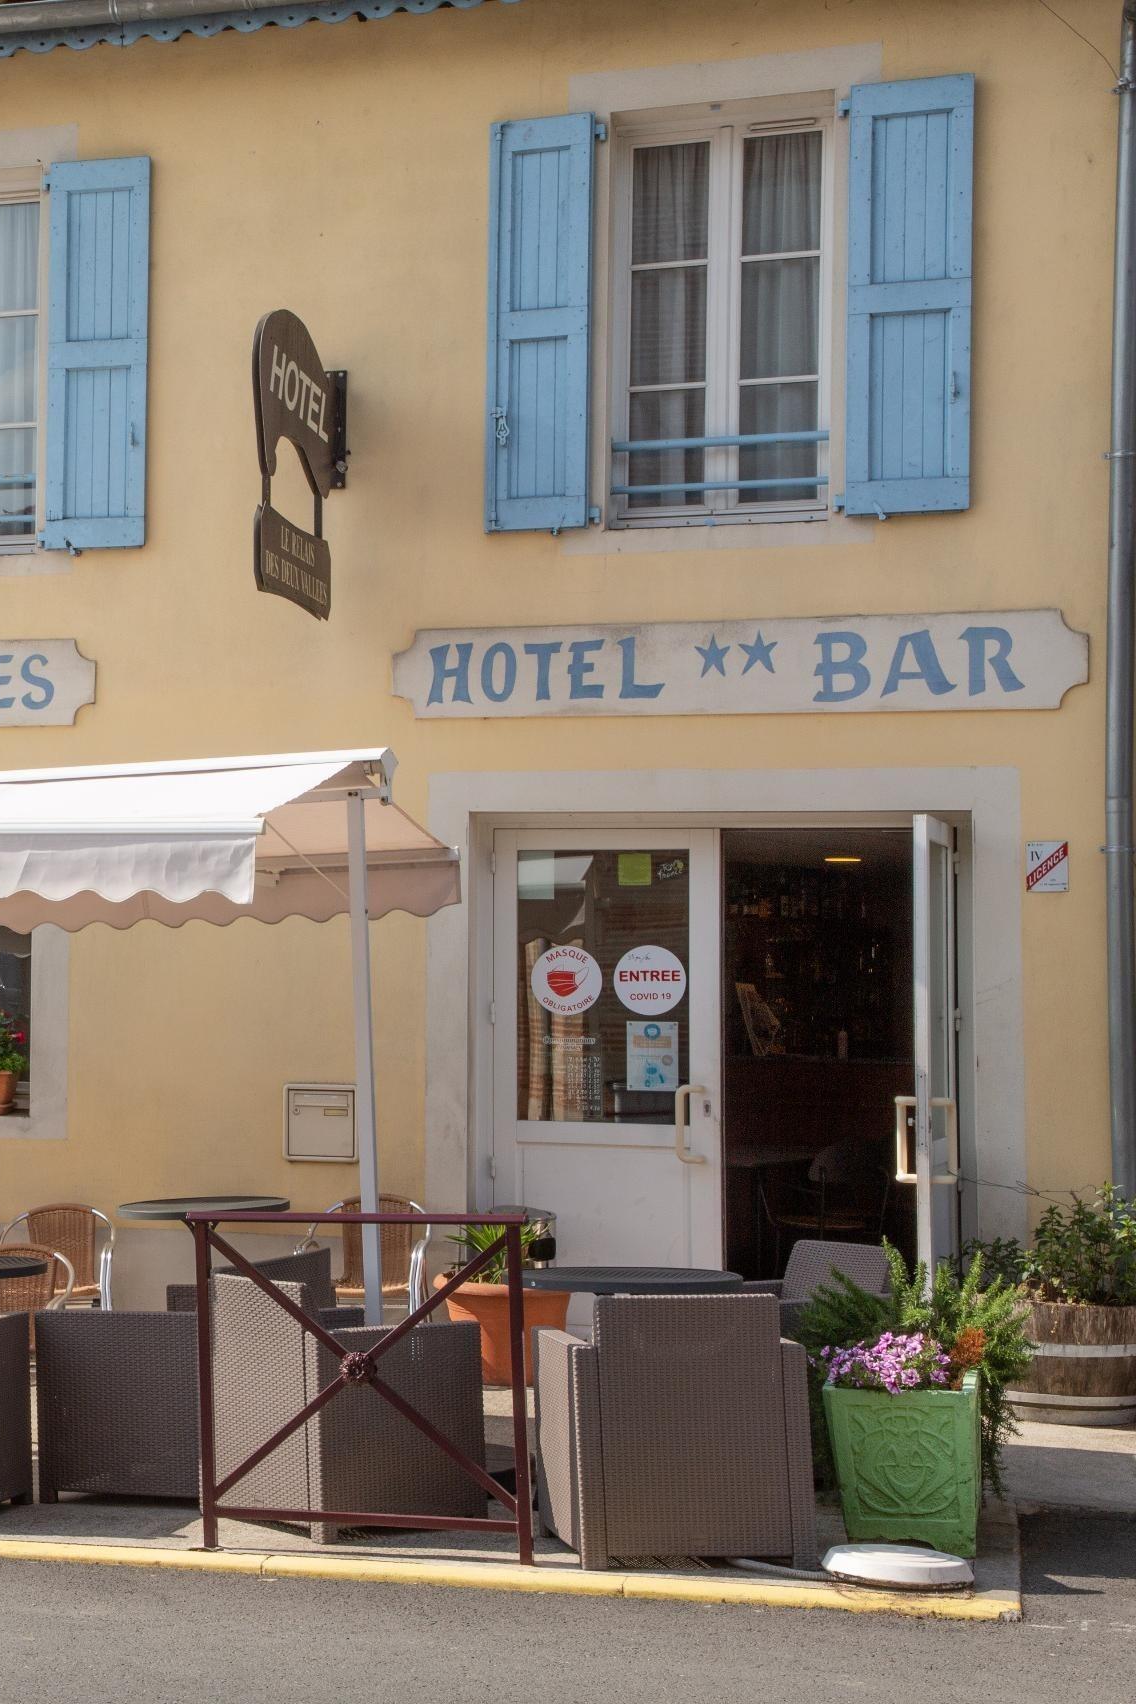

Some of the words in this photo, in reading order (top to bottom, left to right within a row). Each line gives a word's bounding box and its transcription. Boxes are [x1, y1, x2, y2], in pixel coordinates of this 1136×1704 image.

[269, 344, 329, 443] HOTEL
[280, 525, 290, 552] LE
[291, 532, 315, 567] RELAIS
[265, 550, 280, 579] DES
[281, 559, 300, 591] DEUX
[301, 569, 328, 606] VALLEES
[426, 637, 665, 707] HOTEL
[811, 625, 1026, 703] BAR
[1028, 846, 1065, 886] LICENCE
[1031, 850, 1042, 861] IV
[545, 949, 589, 965] MASQUE
[619, 970, 681, 983] ENTREE
[542, 994, 595, 1012] OBLIGATOIRE
[630, 992, 659, 1001] COVID
[662, 992, 672, 1000] 19
